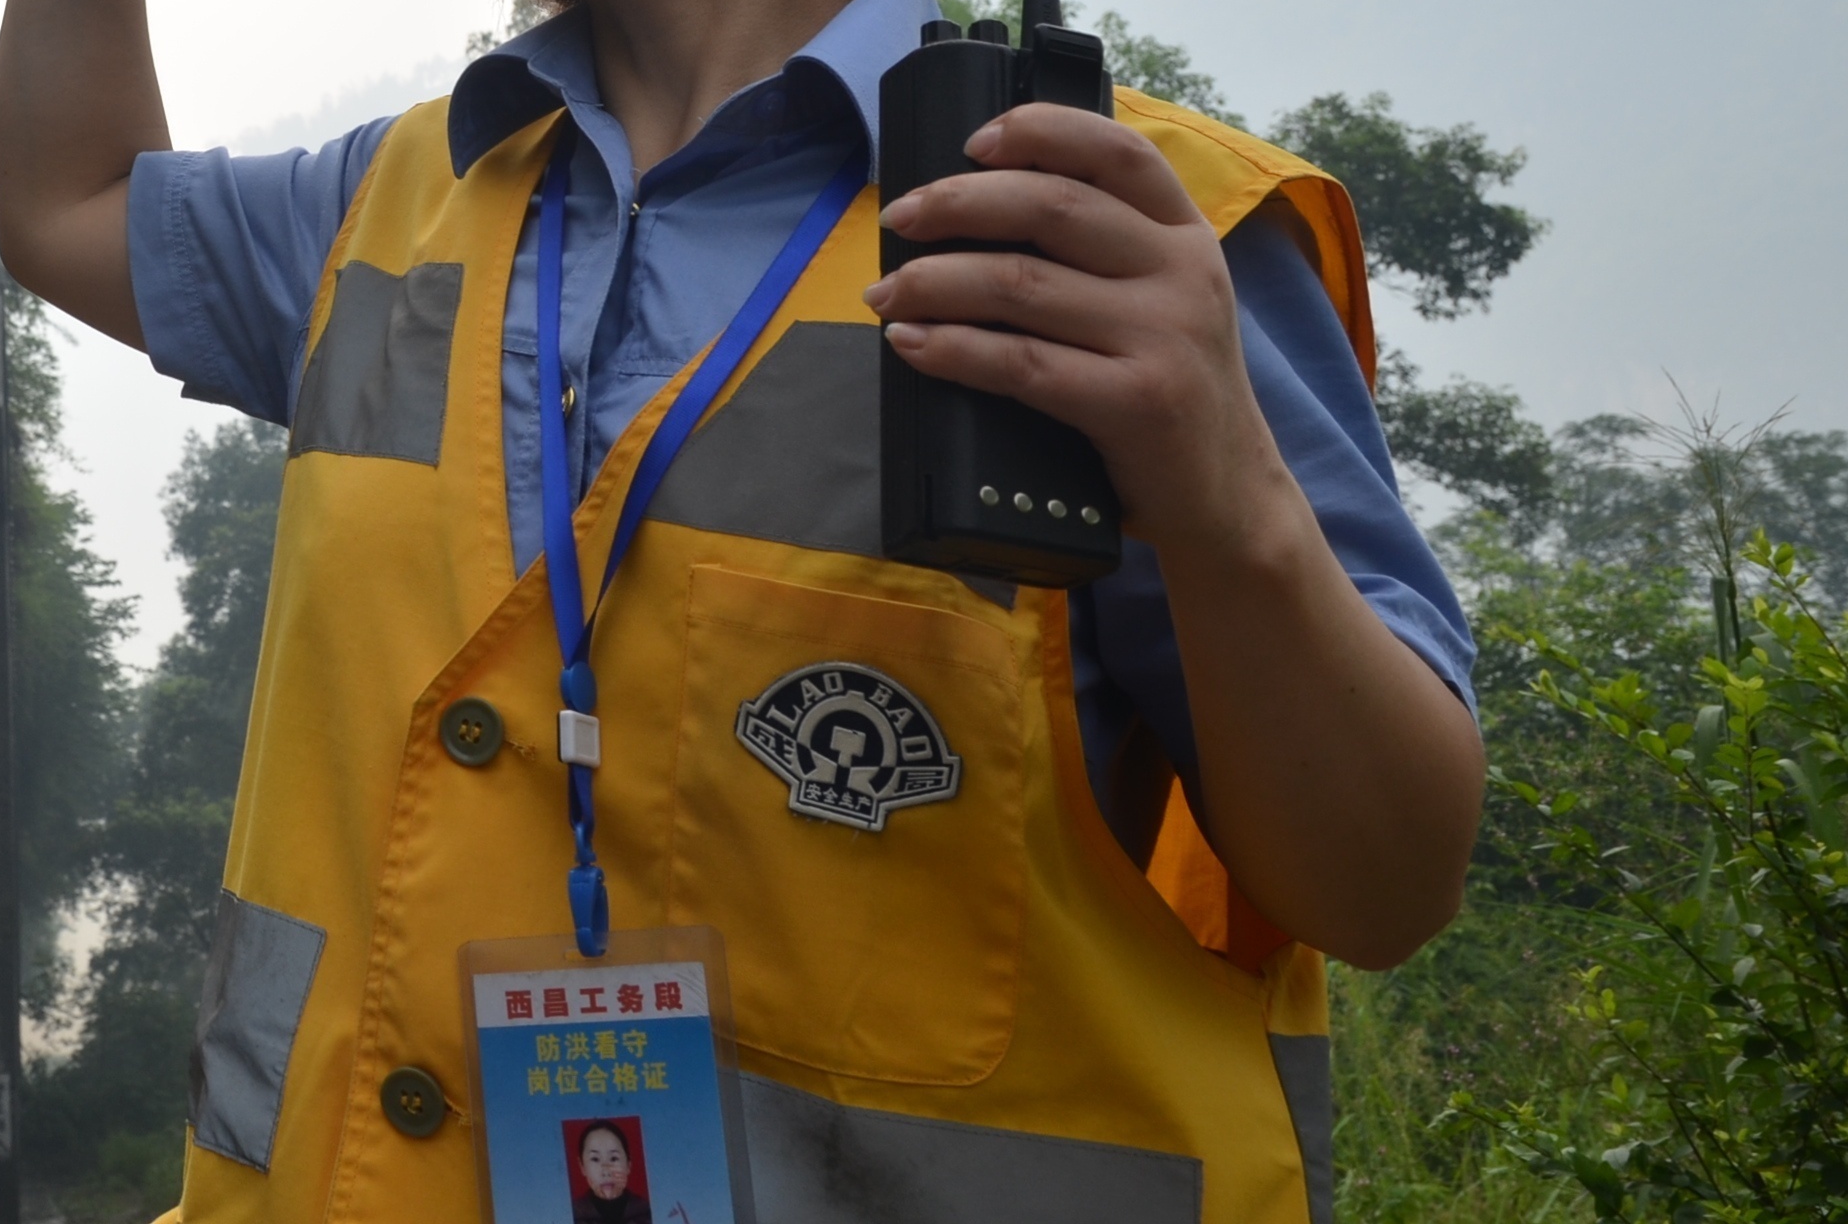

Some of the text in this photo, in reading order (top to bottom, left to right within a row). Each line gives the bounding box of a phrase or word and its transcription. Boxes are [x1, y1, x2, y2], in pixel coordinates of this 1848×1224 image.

[765, 672, 934, 761] LAO BAO
[805, 782, 872, 811] 安全生产
[505, 982, 684, 1020] 西昌工务段
[536, 1029, 648, 1062] 防洪看守
[526, 1062, 670, 1096] 岗位合格证
